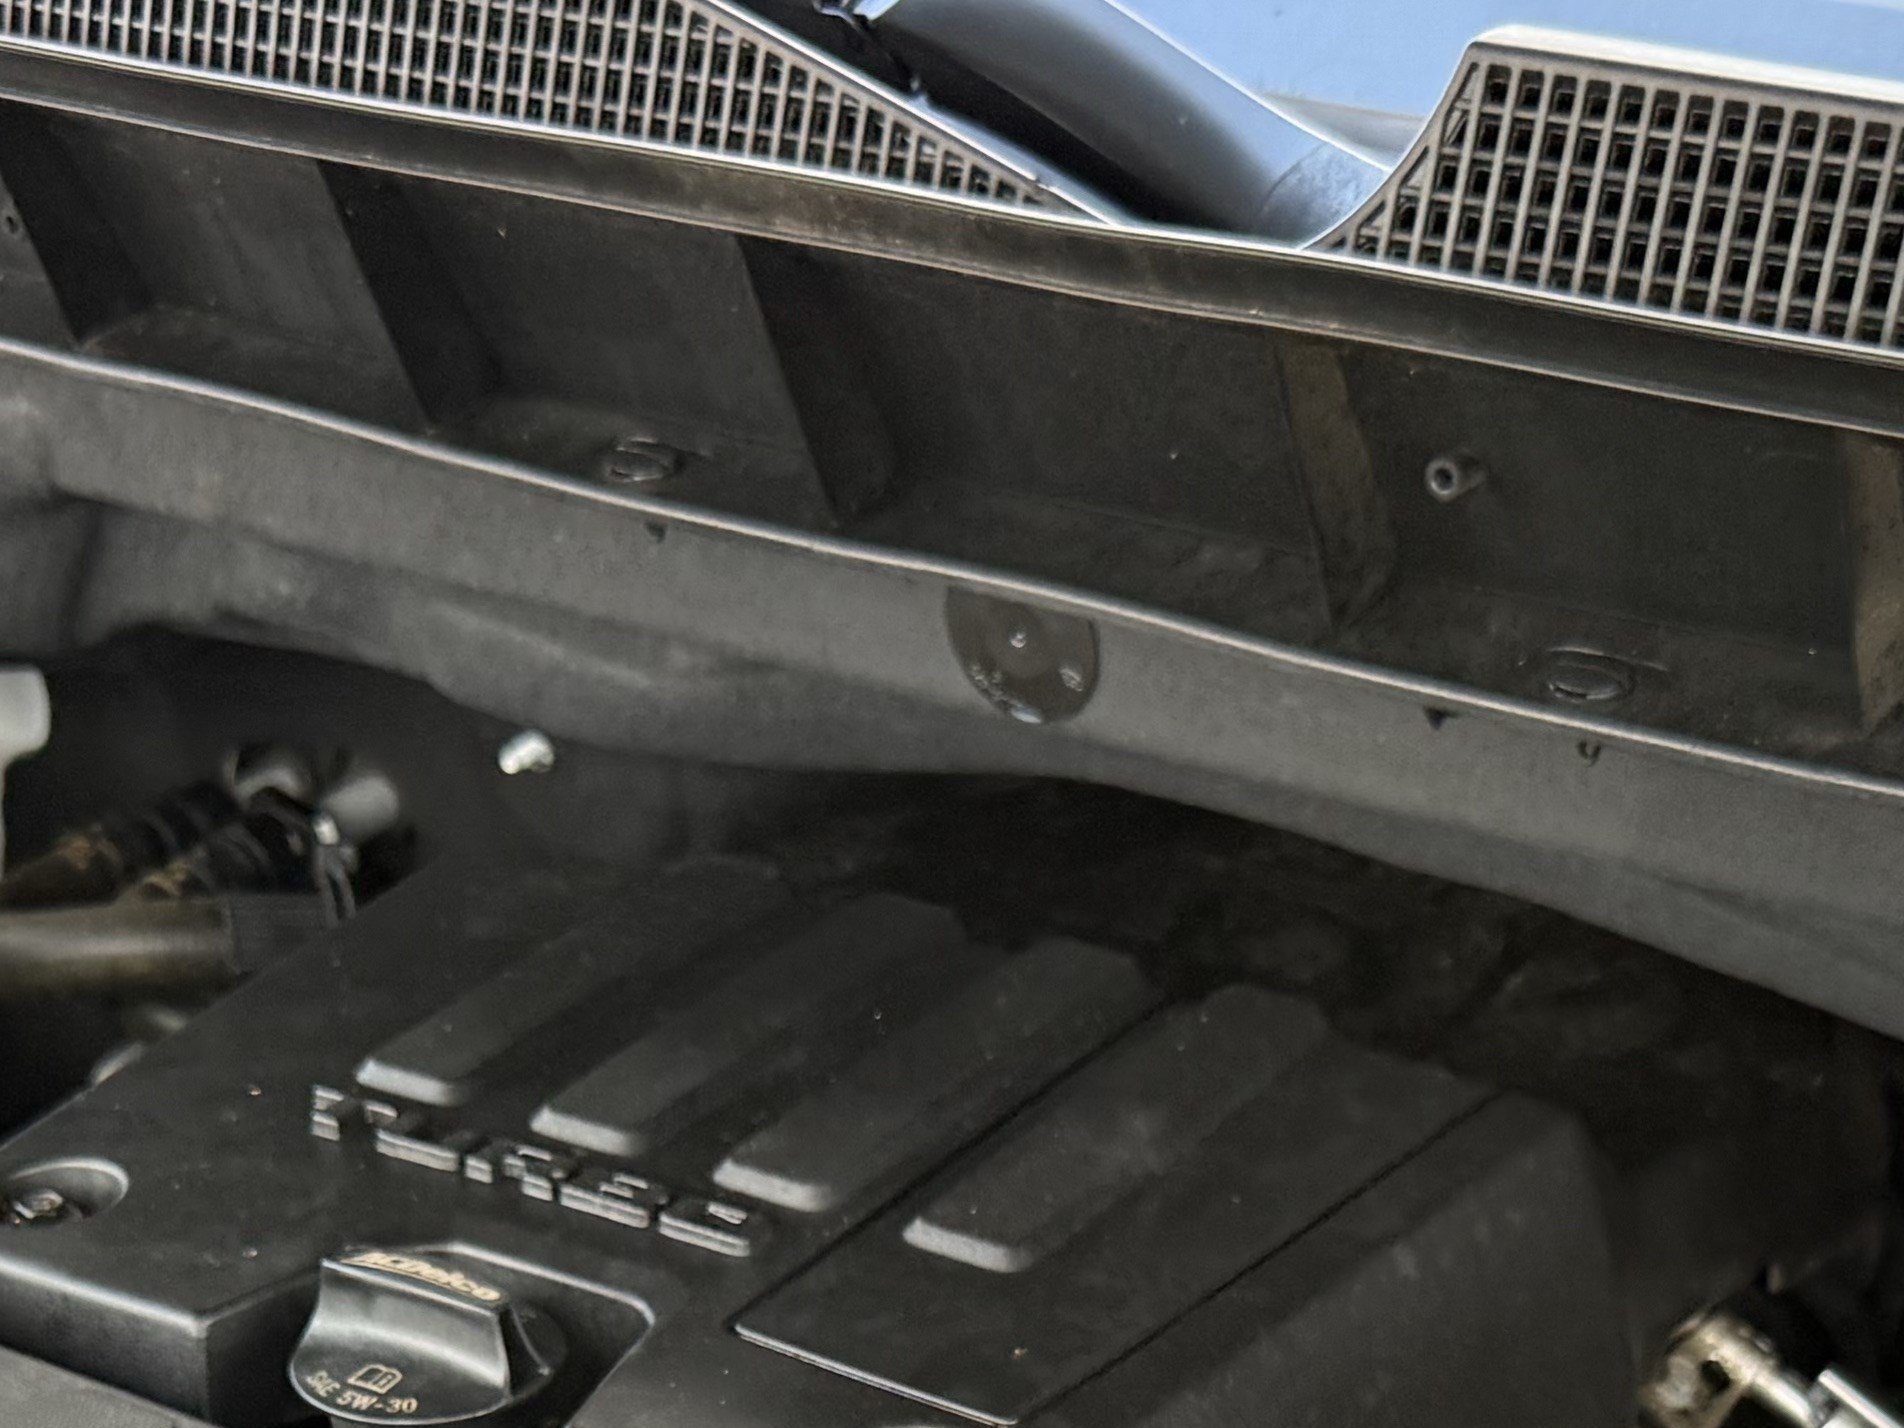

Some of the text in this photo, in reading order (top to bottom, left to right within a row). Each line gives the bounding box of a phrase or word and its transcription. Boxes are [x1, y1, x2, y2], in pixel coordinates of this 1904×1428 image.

[341, 1252, 501, 1301] ACDelco
[305, 1370, 418, 1413] SAE 5W-30
